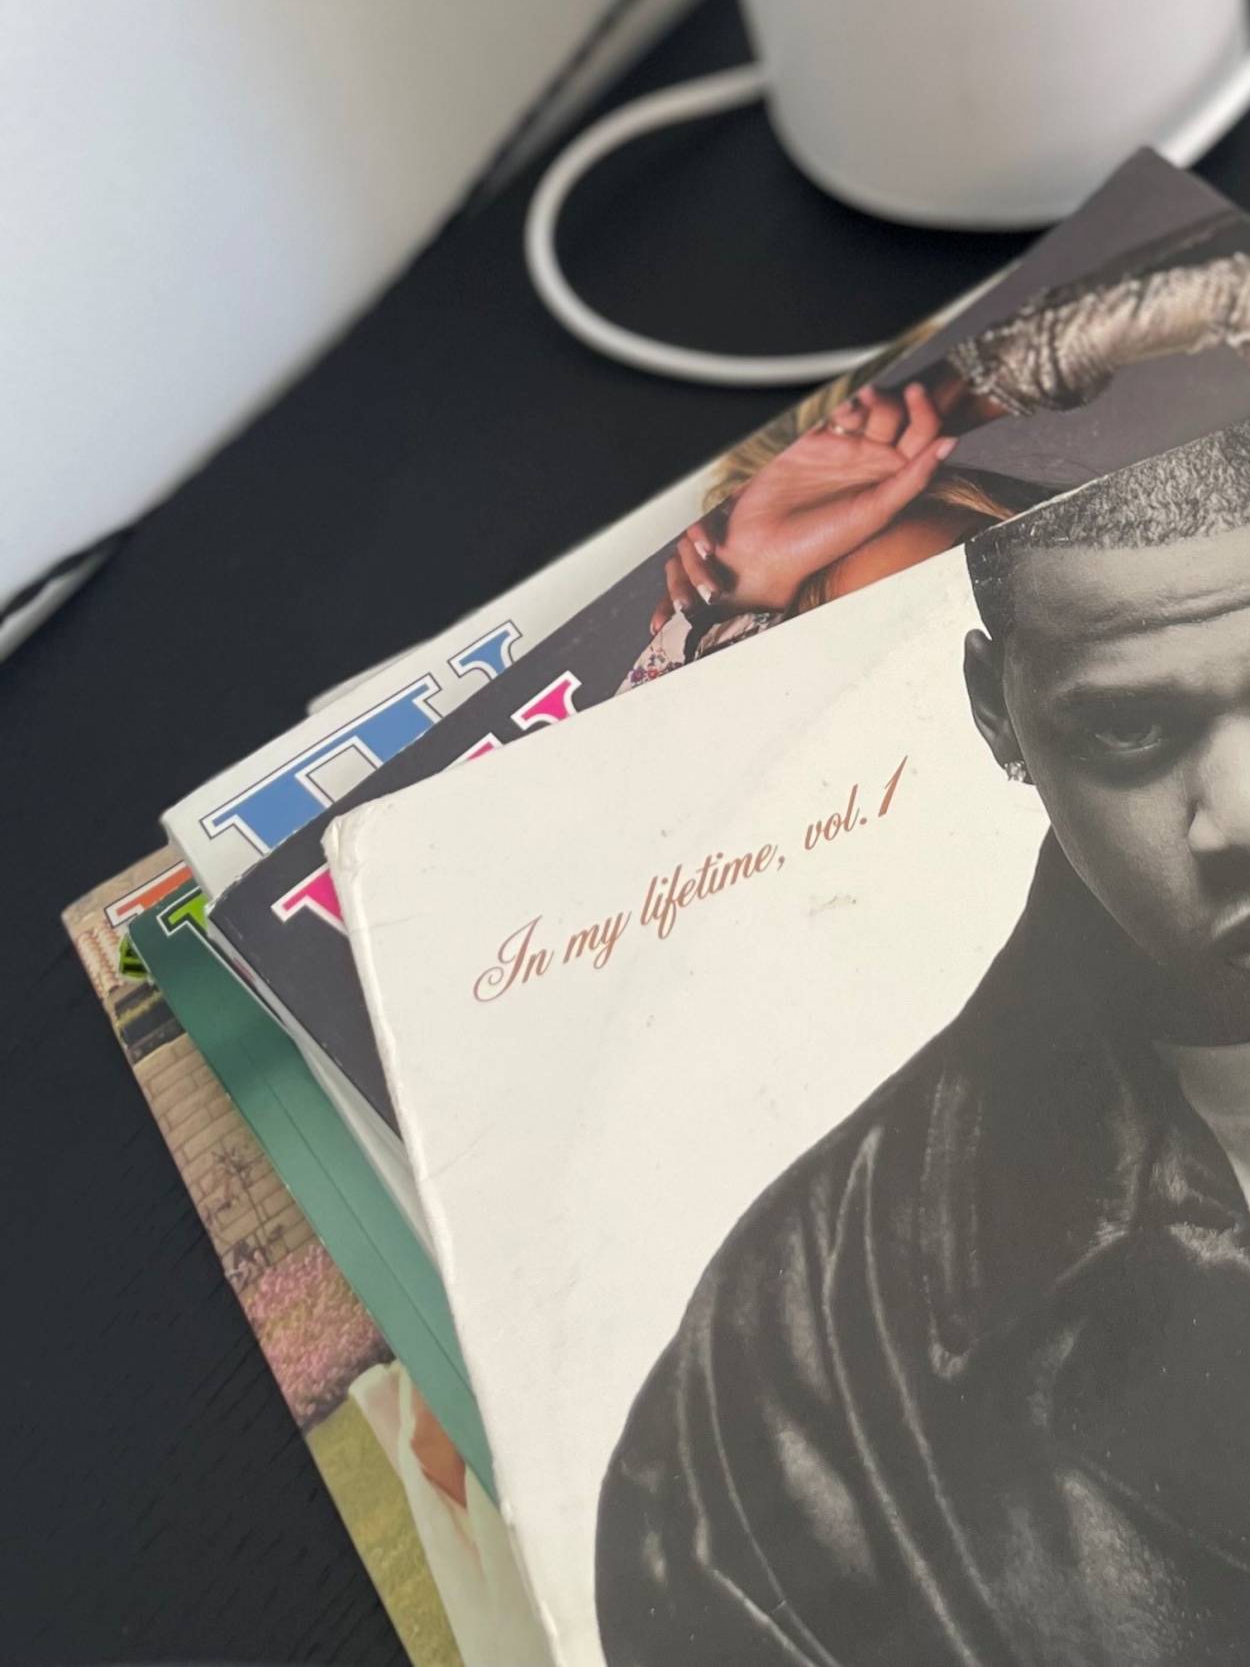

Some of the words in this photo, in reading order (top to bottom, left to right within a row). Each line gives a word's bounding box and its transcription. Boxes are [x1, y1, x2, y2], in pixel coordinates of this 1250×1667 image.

[473, 915, 555, 1003] In
[562, 910, 632, 970] my
[640, 843, 786, 940] lifetime,
